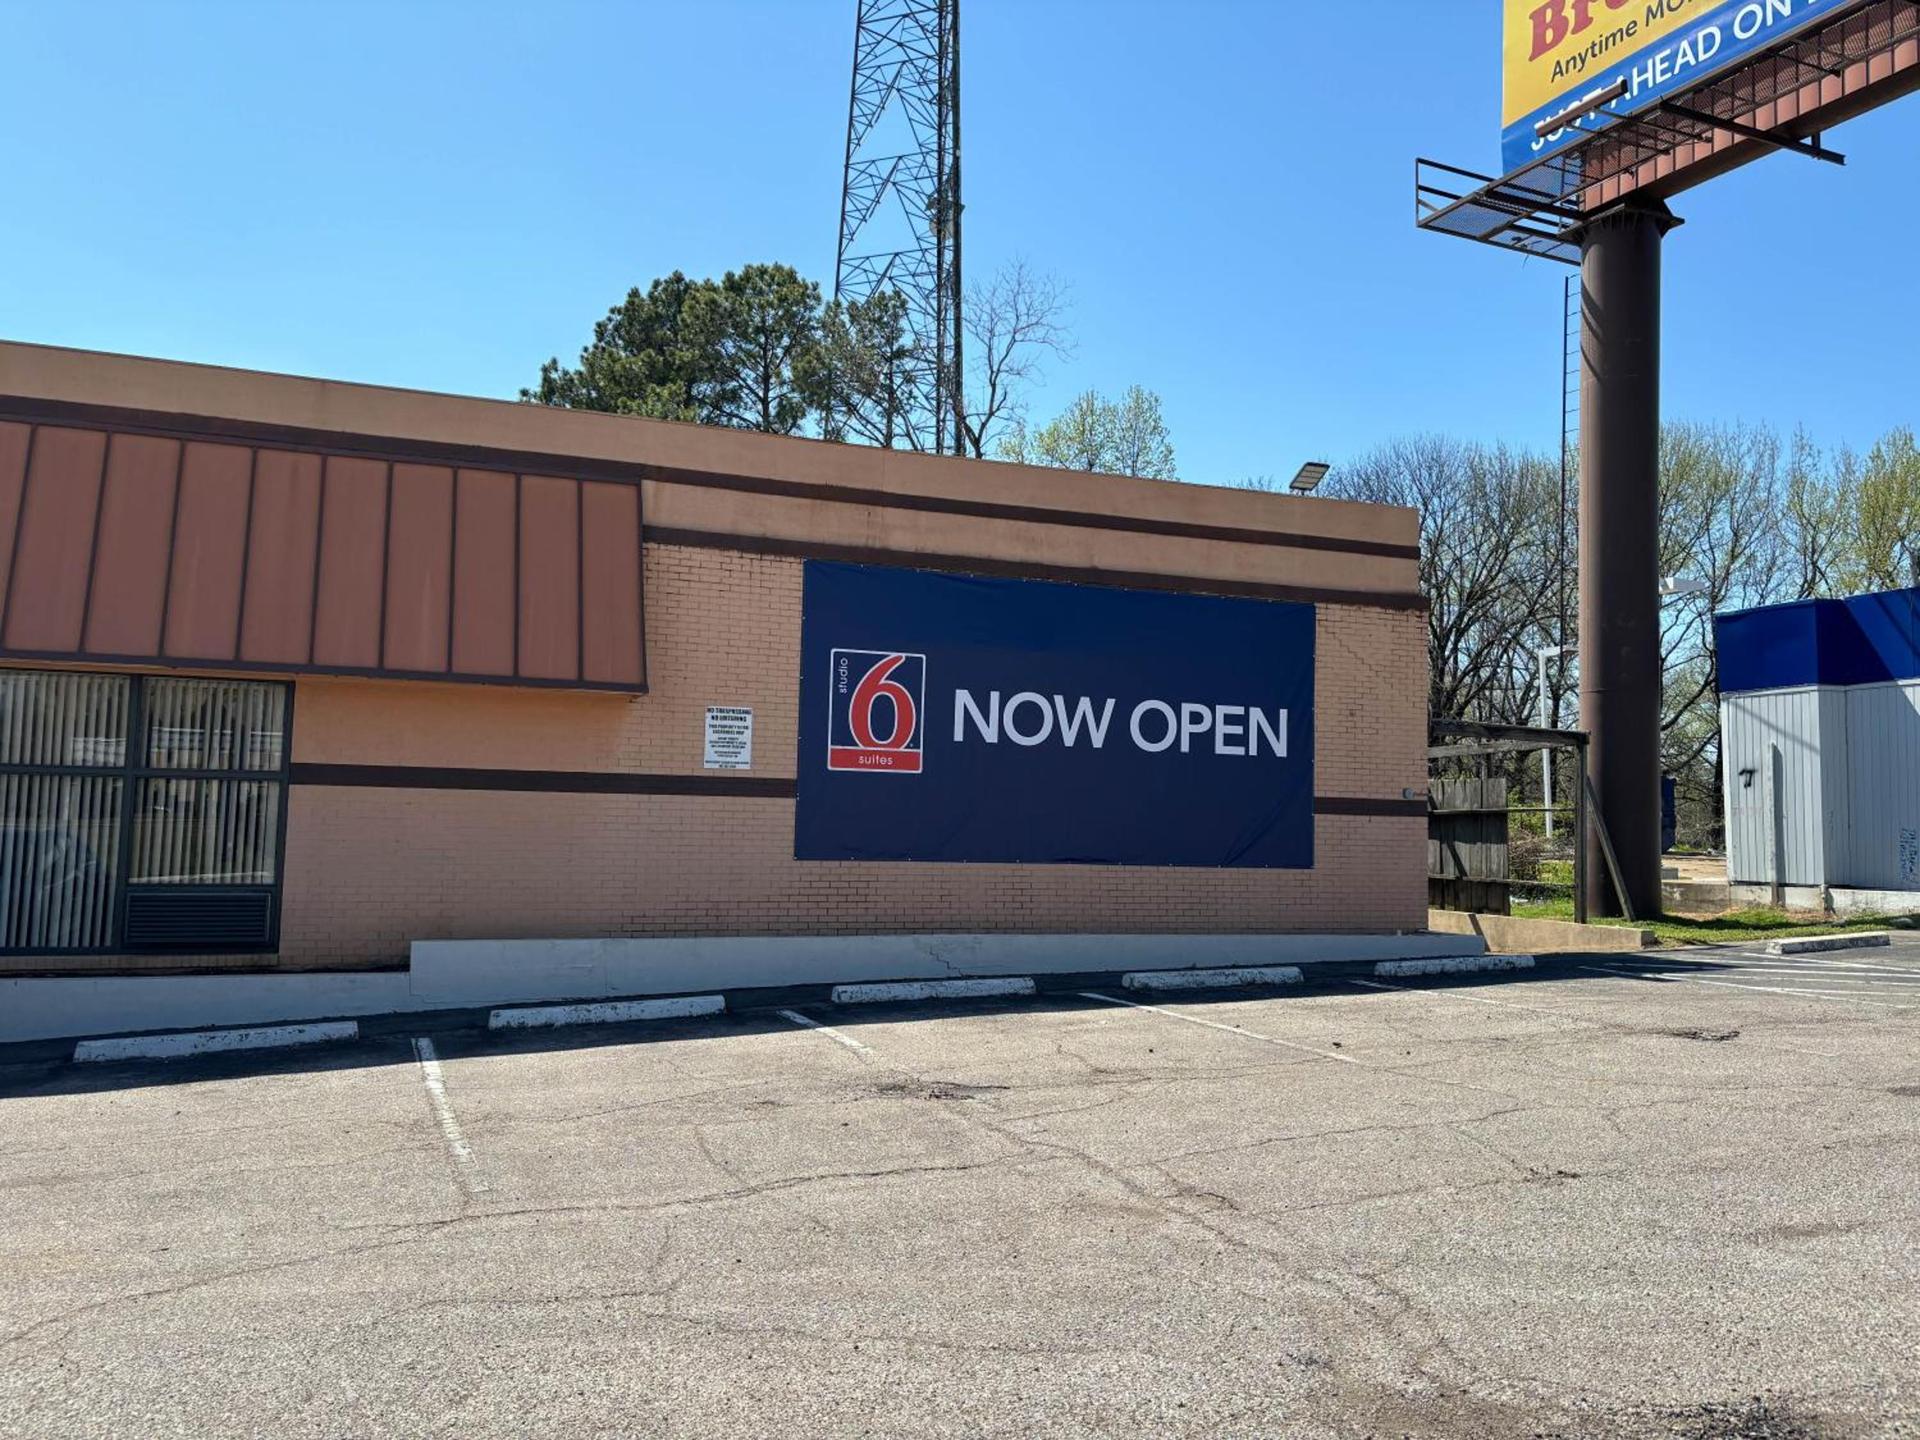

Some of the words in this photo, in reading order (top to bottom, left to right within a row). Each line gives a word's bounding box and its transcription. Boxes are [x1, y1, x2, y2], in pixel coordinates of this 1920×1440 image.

[1529, 0, 1630, 62] Br
[1551, 20, 1638, 83] Anytime
[1611, 26, 1721, 109] AHEAD
[1733, 0, 1791, 40] ON
[838, 657, 849, 694] studio
[849, 653, 916, 750] 6
[953, 689, 1116, 749] NOW
[1130, 699, 1288, 758] OPEN
[858, 754, 894, 766] suites
